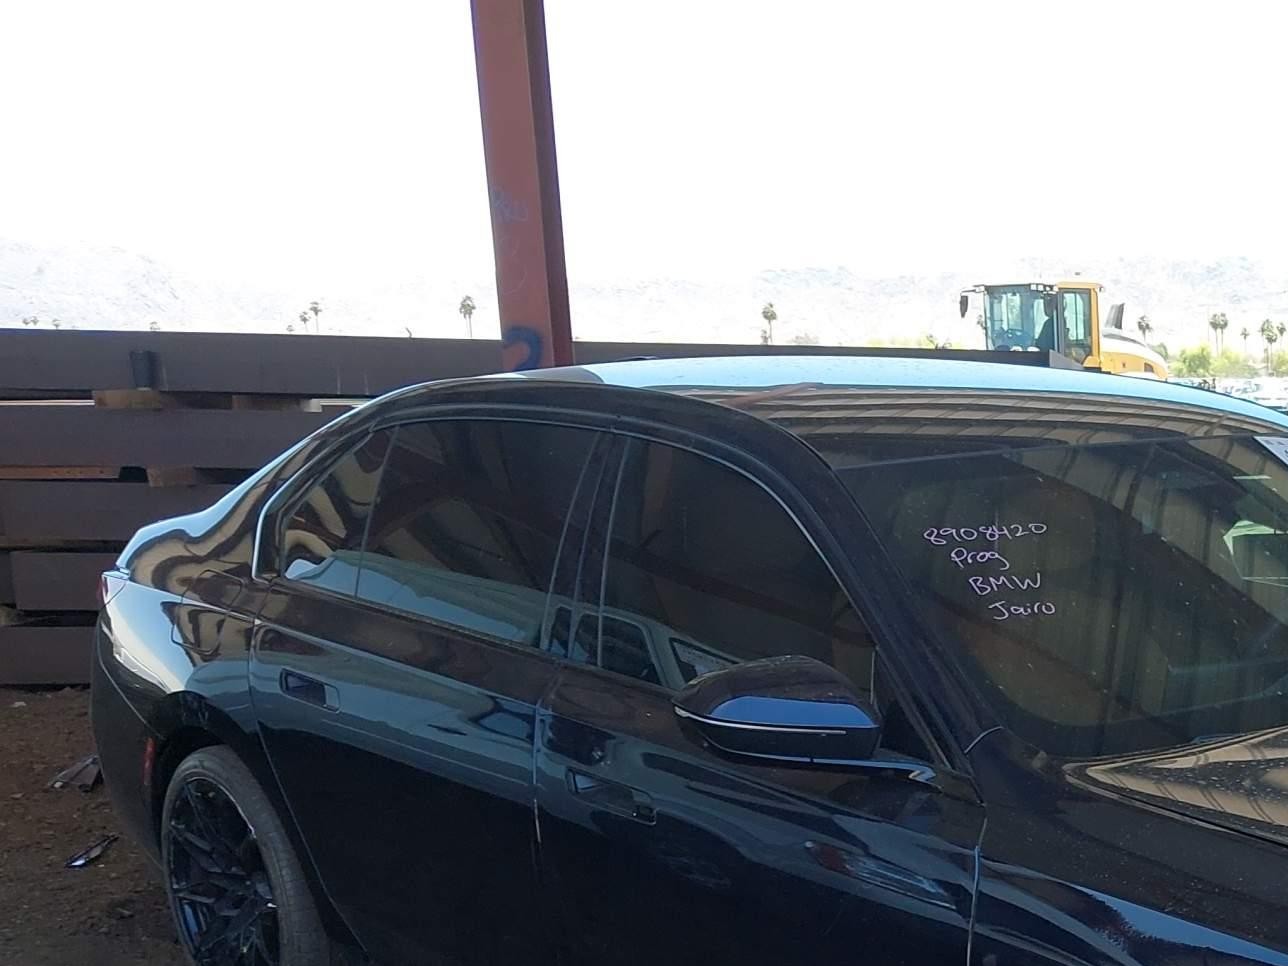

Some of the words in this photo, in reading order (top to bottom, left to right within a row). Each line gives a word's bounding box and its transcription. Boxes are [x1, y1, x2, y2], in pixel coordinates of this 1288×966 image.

[923, 523, 1047, 545] 8908420
[969, 572, 1041, 595] BMW
[988, 601, 1056, 620] Jairo
